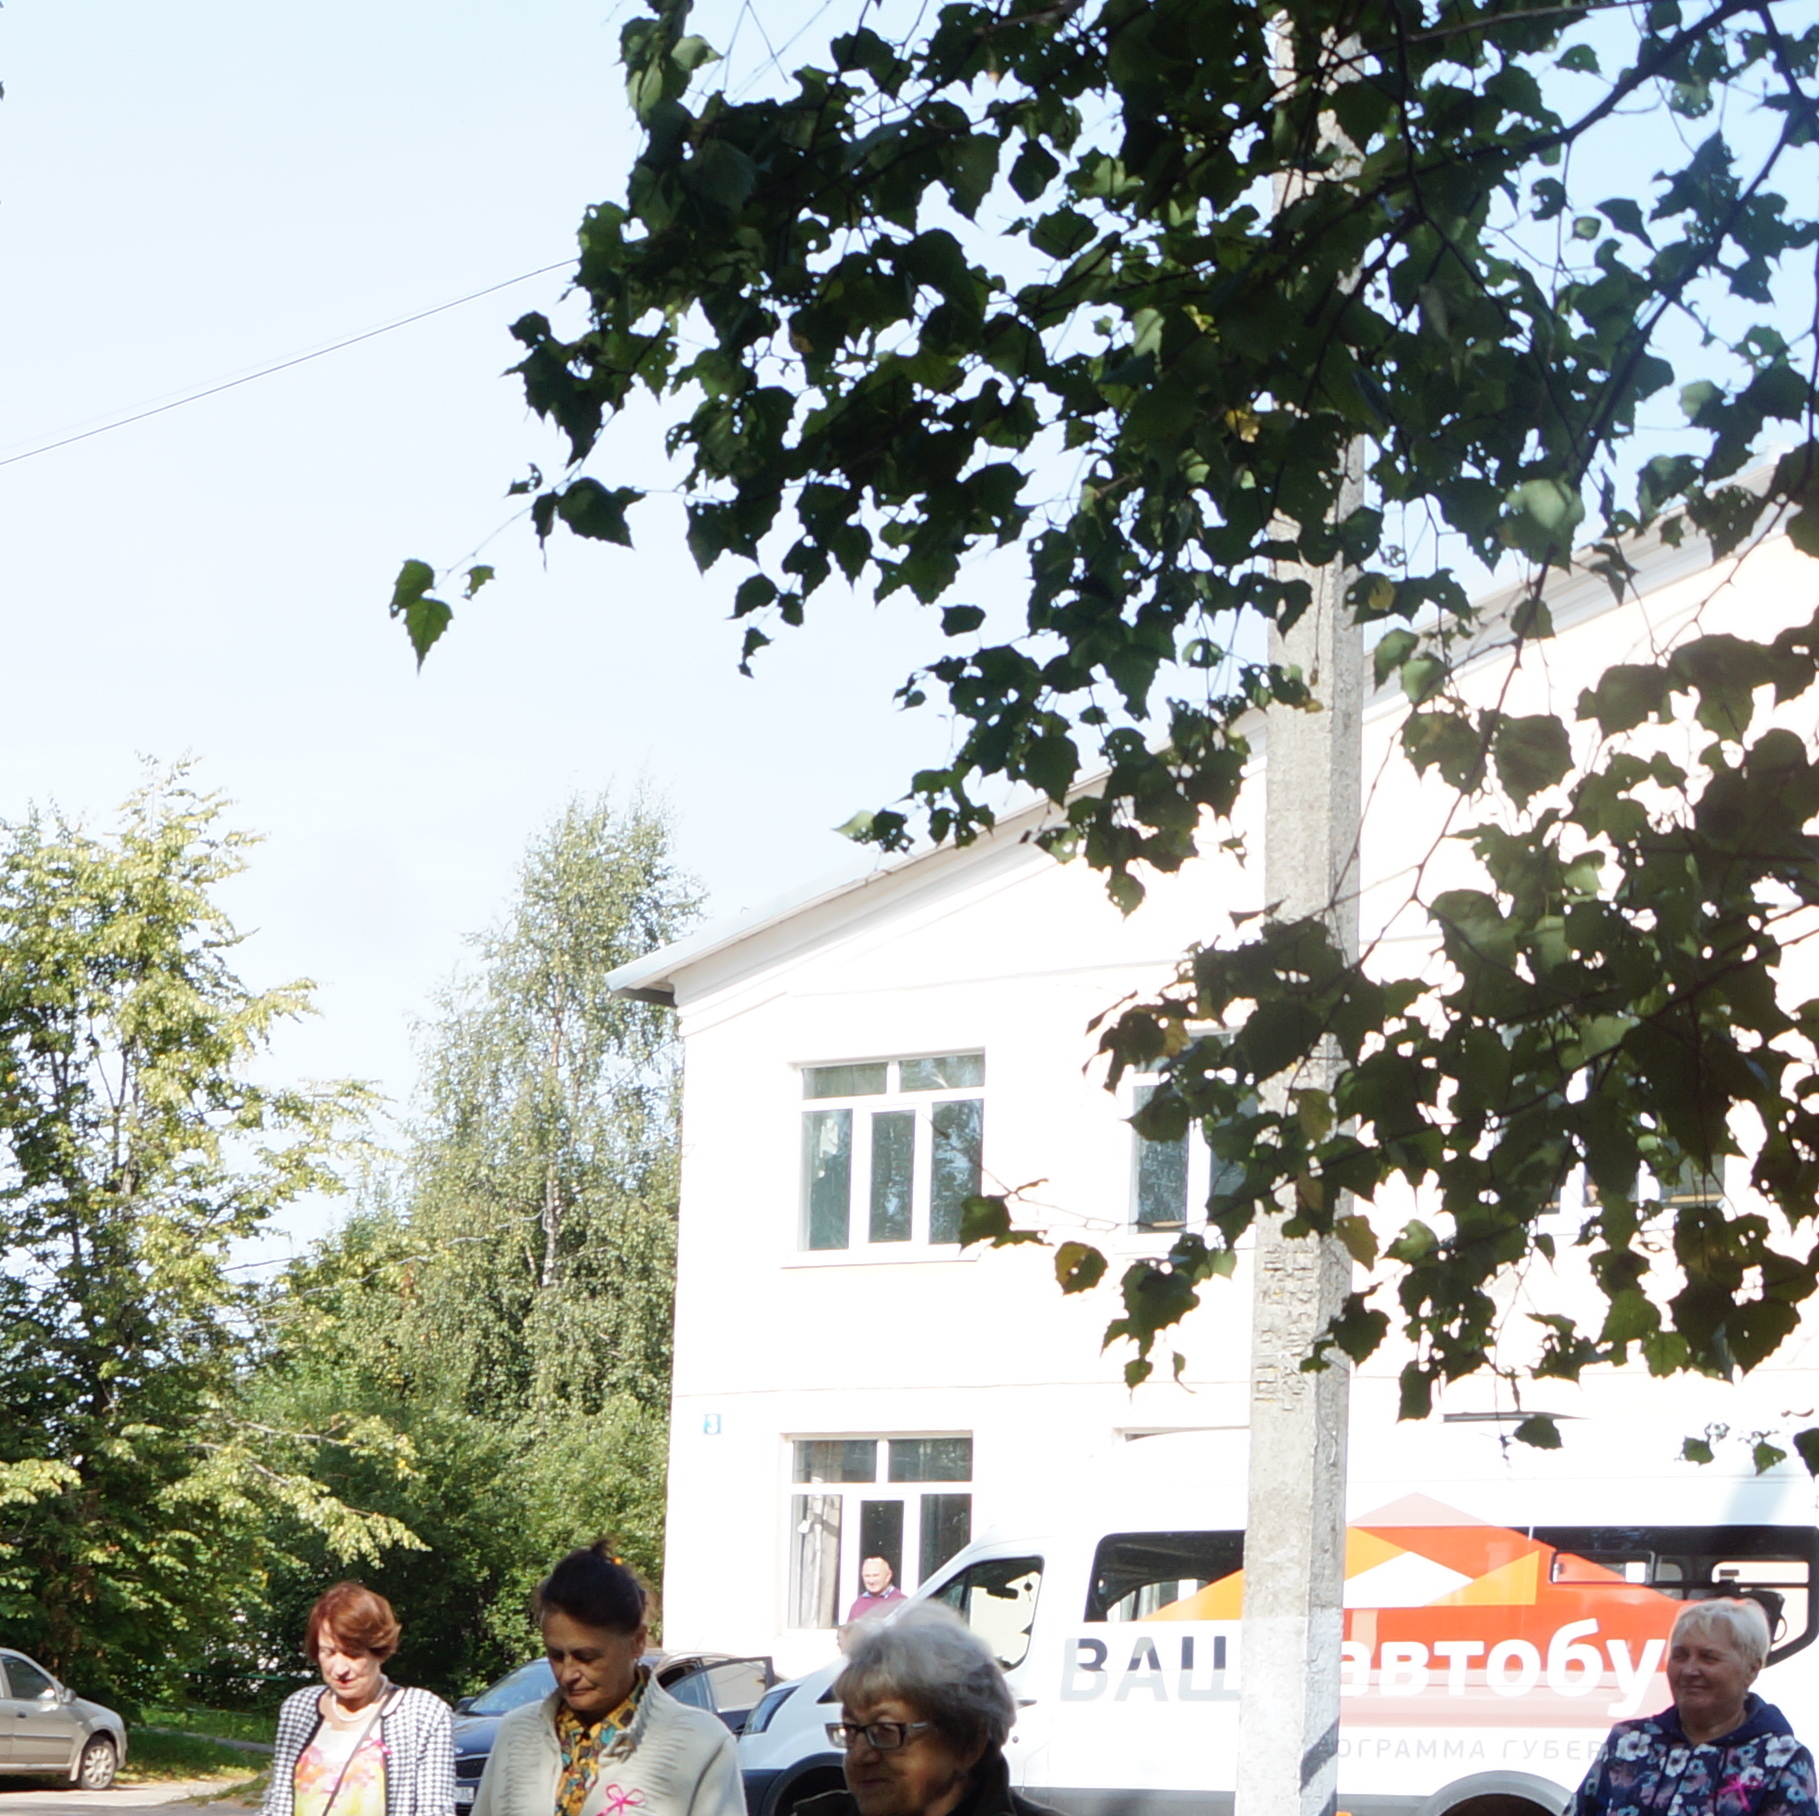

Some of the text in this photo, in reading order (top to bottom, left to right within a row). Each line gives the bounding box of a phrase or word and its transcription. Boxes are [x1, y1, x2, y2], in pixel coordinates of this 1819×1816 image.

[1059, 1617, 1667, 1718] ВАШ автобу
[1338, 1738, 1604, 1760] ОГРАММА ГУБЕР
